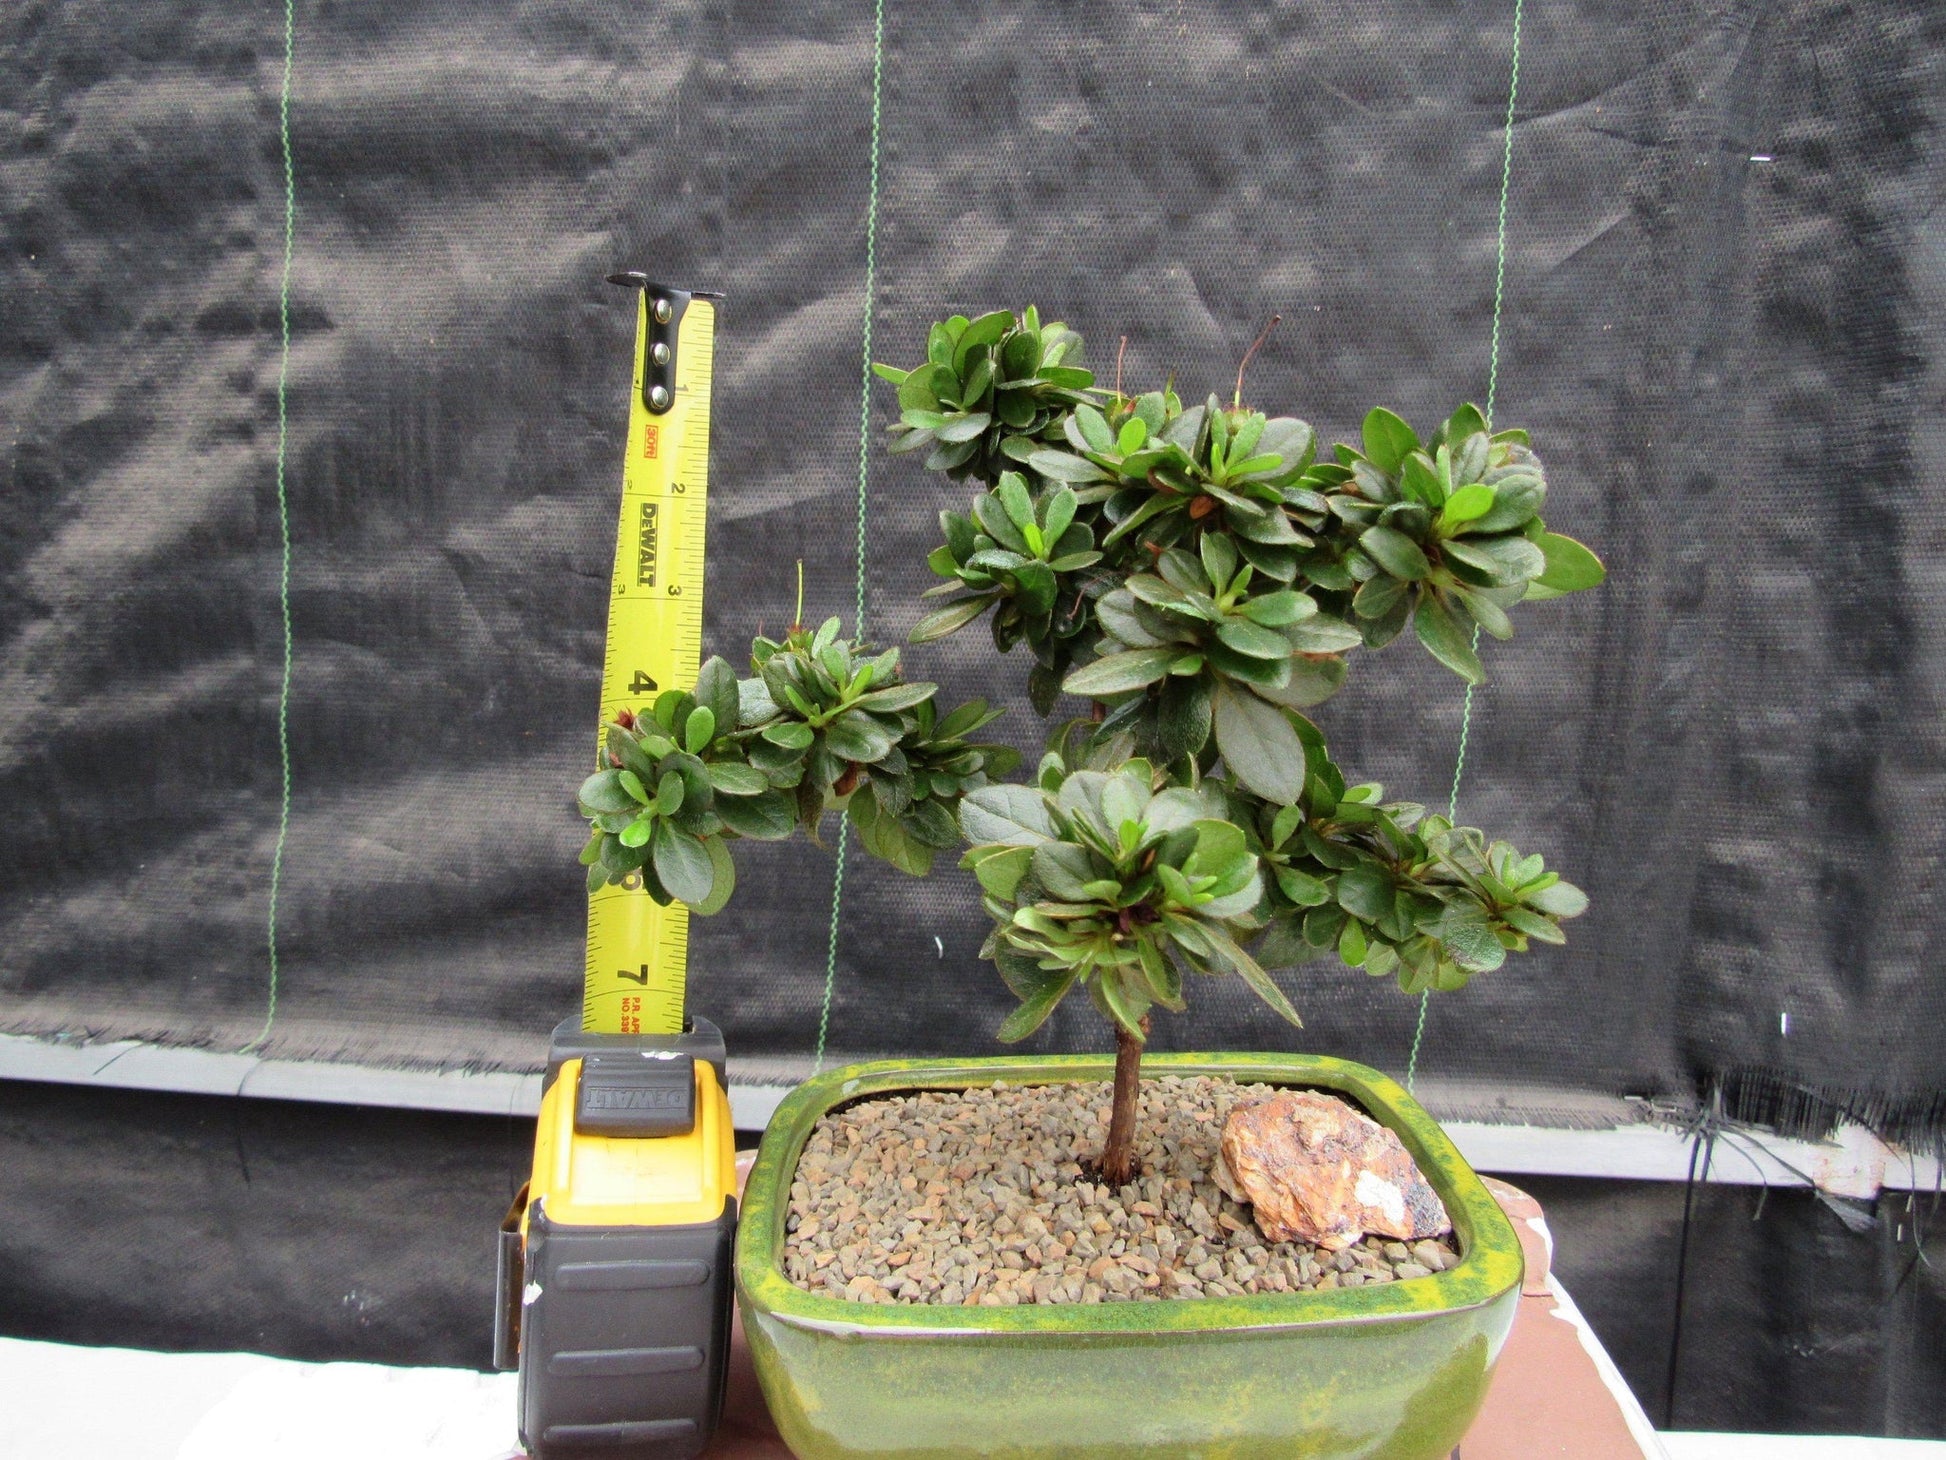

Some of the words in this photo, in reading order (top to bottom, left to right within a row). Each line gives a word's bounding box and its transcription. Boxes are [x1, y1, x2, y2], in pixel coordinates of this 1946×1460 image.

[675, 384, 689, 392] 1
[671, 483, 686, 494] 2
[618, 584, 626, 595] 3
[668, 585, 682, 596] 3
[628, 670, 658, 695] 4
[617, 964, 648, 985] 7
